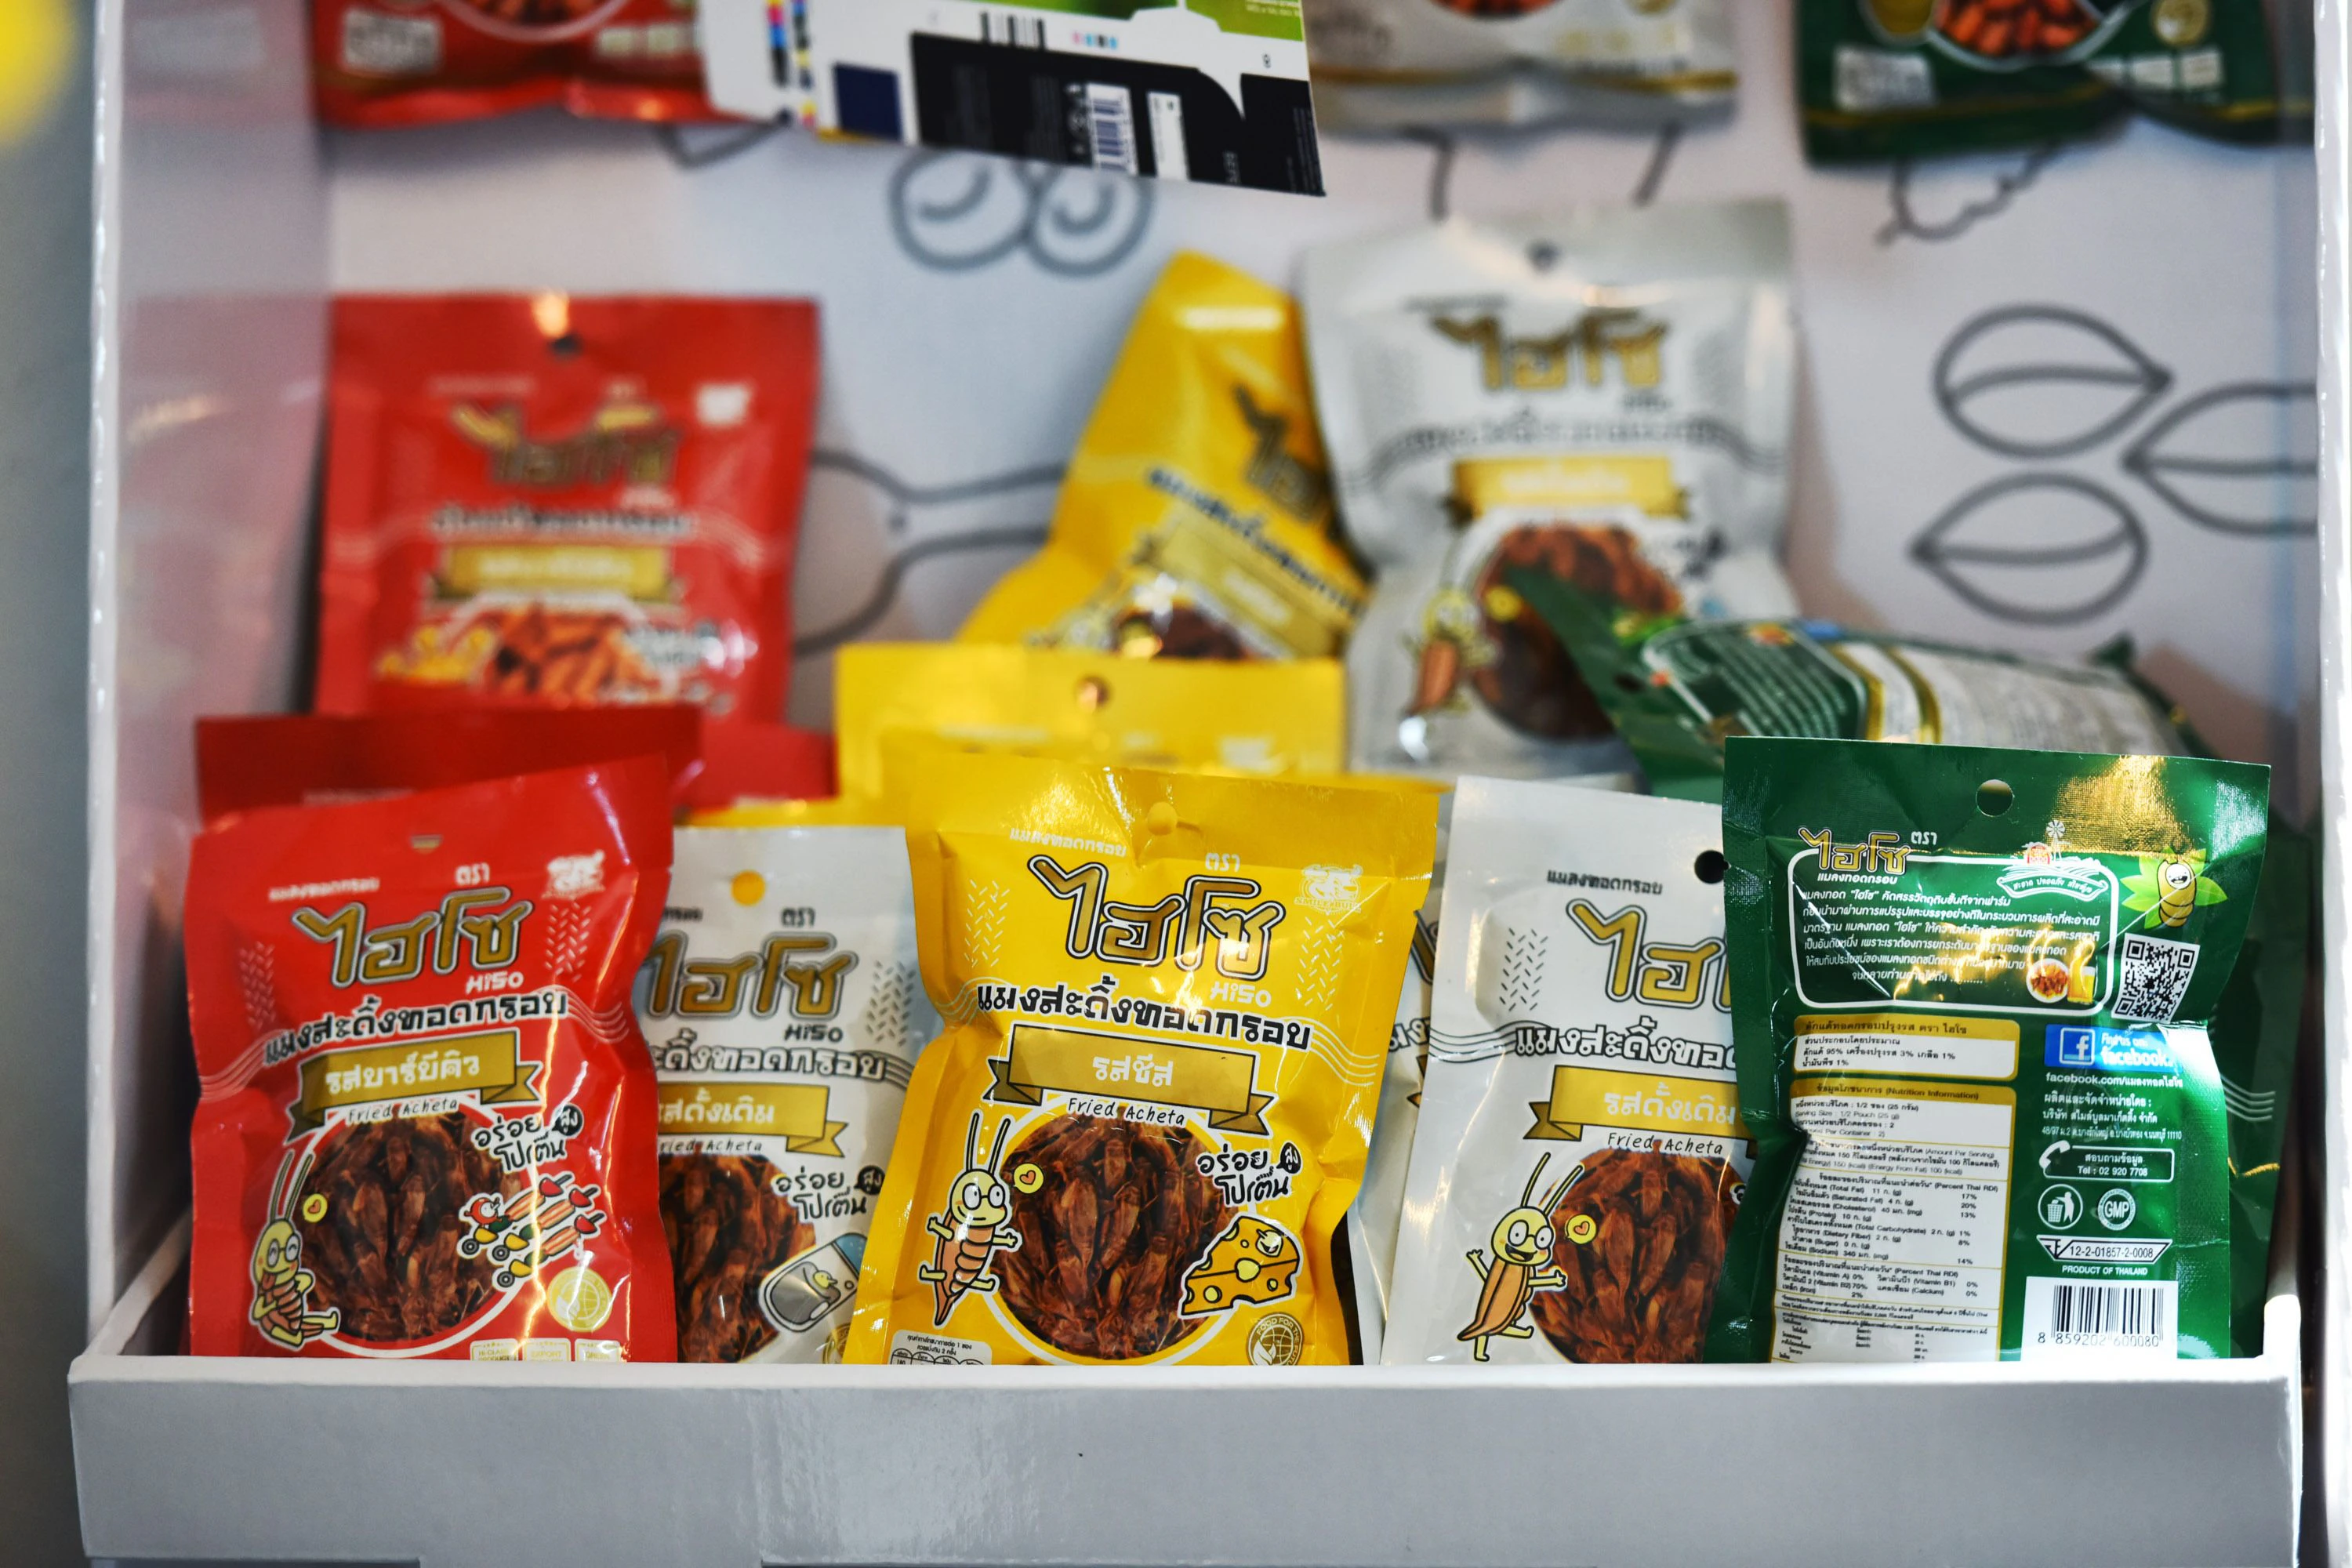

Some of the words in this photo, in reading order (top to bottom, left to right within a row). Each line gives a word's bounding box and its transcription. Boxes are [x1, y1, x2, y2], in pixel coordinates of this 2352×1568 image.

[1911, 830, 1937, 845] ตรา
[1798, 826, 1911, 876] ไฮโซ
[1205, 853, 1240, 872] ตรา
[455, 863, 490, 885] ตรา
[781, 907, 815, 927] ตรา
[1027, 853, 1286, 981] ไฮโซ
[292, 885, 533, 988] ไฮโซ
[1566, 898, 1732, 1014] ไฮ
[977, 976, 1312, 1051] แมงสะดิ้งทอดกรอบ
[325, 1049, 480, 1094] รสบาร์บีคิว
[1092, 1054, 1174, 1087] รสชีส
[1604, 1082, 1736, 1125] รสดั้งเดิม
[1886, 1087, 1925, 1097] (Nutrition
[1928, 1090, 1979, 1100] Information)
[347, 1104, 392, 1122] Fried
[402, 1099, 459, 1119] Acheta
[1067, 1097, 1114, 1116] Fried
[1126, 1108, 1186, 1127] Acheta
[659, 1138, 695, 1152] ried
[706, 1138, 764, 1152] Acheta
[1607, 1133, 1653, 1149] Fried
[1664, 1138, 1723, 1155] Acheta
[1196, 1144, 1269, 1174] อร่อย
[2078, 1165, 2090, 1174] Tel
[2112, 1167, 2127, 1176] 920
[2104, 1200, 2129, 1218] GMP
[2071, 1245, 2154, 1258] 12-2-01857-2-0008
[2062, 1265, 2100, 1275] PRODUCT
[2103, 1266, 2113, 1275] OF
[2115, 1266, 2148, 1276] THAILAND
[1256, 1318, 1278, 1335] FOOD
[1279, 1317, 1294, 1330] FOR
[2038, 1332, 2046, 1344] 8
[2056, 1333, 2104, 1347] 859202
[2114, 1335, 2159, 1348] 600080
